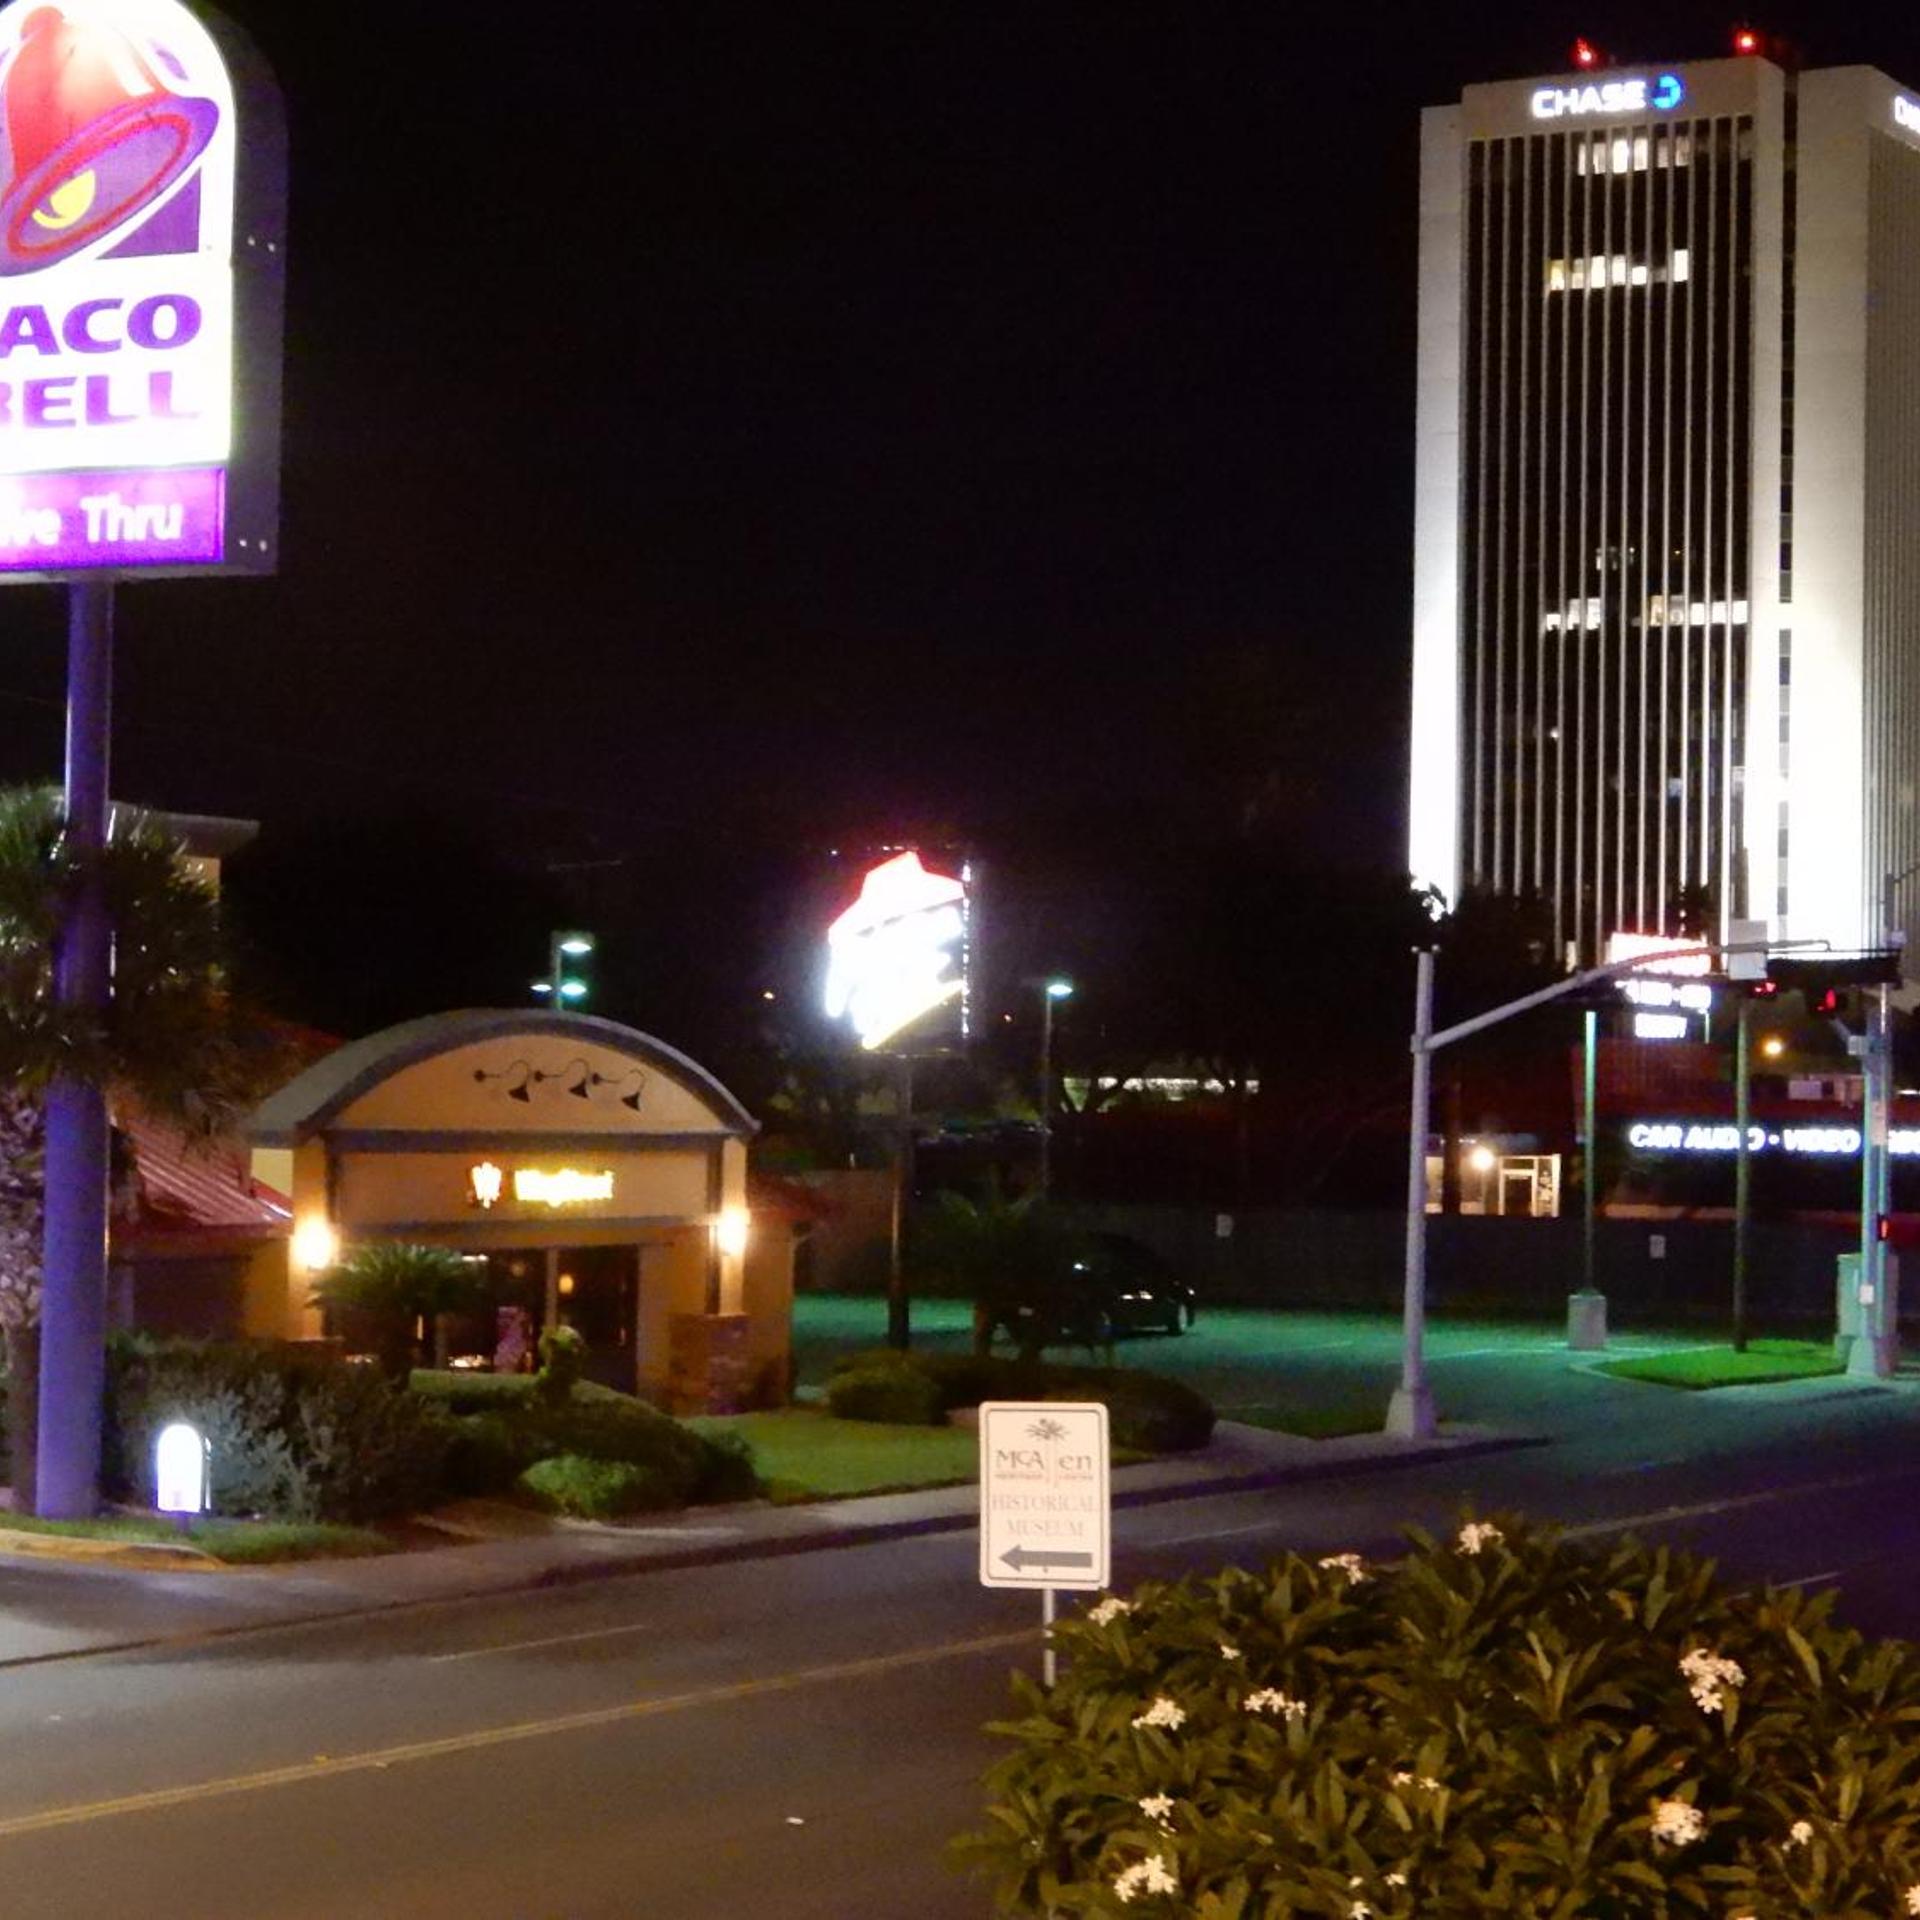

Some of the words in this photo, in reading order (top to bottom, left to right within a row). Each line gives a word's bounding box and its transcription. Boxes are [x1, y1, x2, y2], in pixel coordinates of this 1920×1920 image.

[1531, 80, 1647, 119] CHASE
[79, 492, 184, 542] Thru
[1629, 1124, 1683, 1148] CAR
[1684, 1126, 1766, 1150] AUDO
[1783, 1128, 1861, 1152] VIDEO
[996, 1449, 1092, 1470] McAen
[991, 1494, 1098, 1512] HISTORICAL
[1006, 1519, 1084, 1537] MUSEUM
